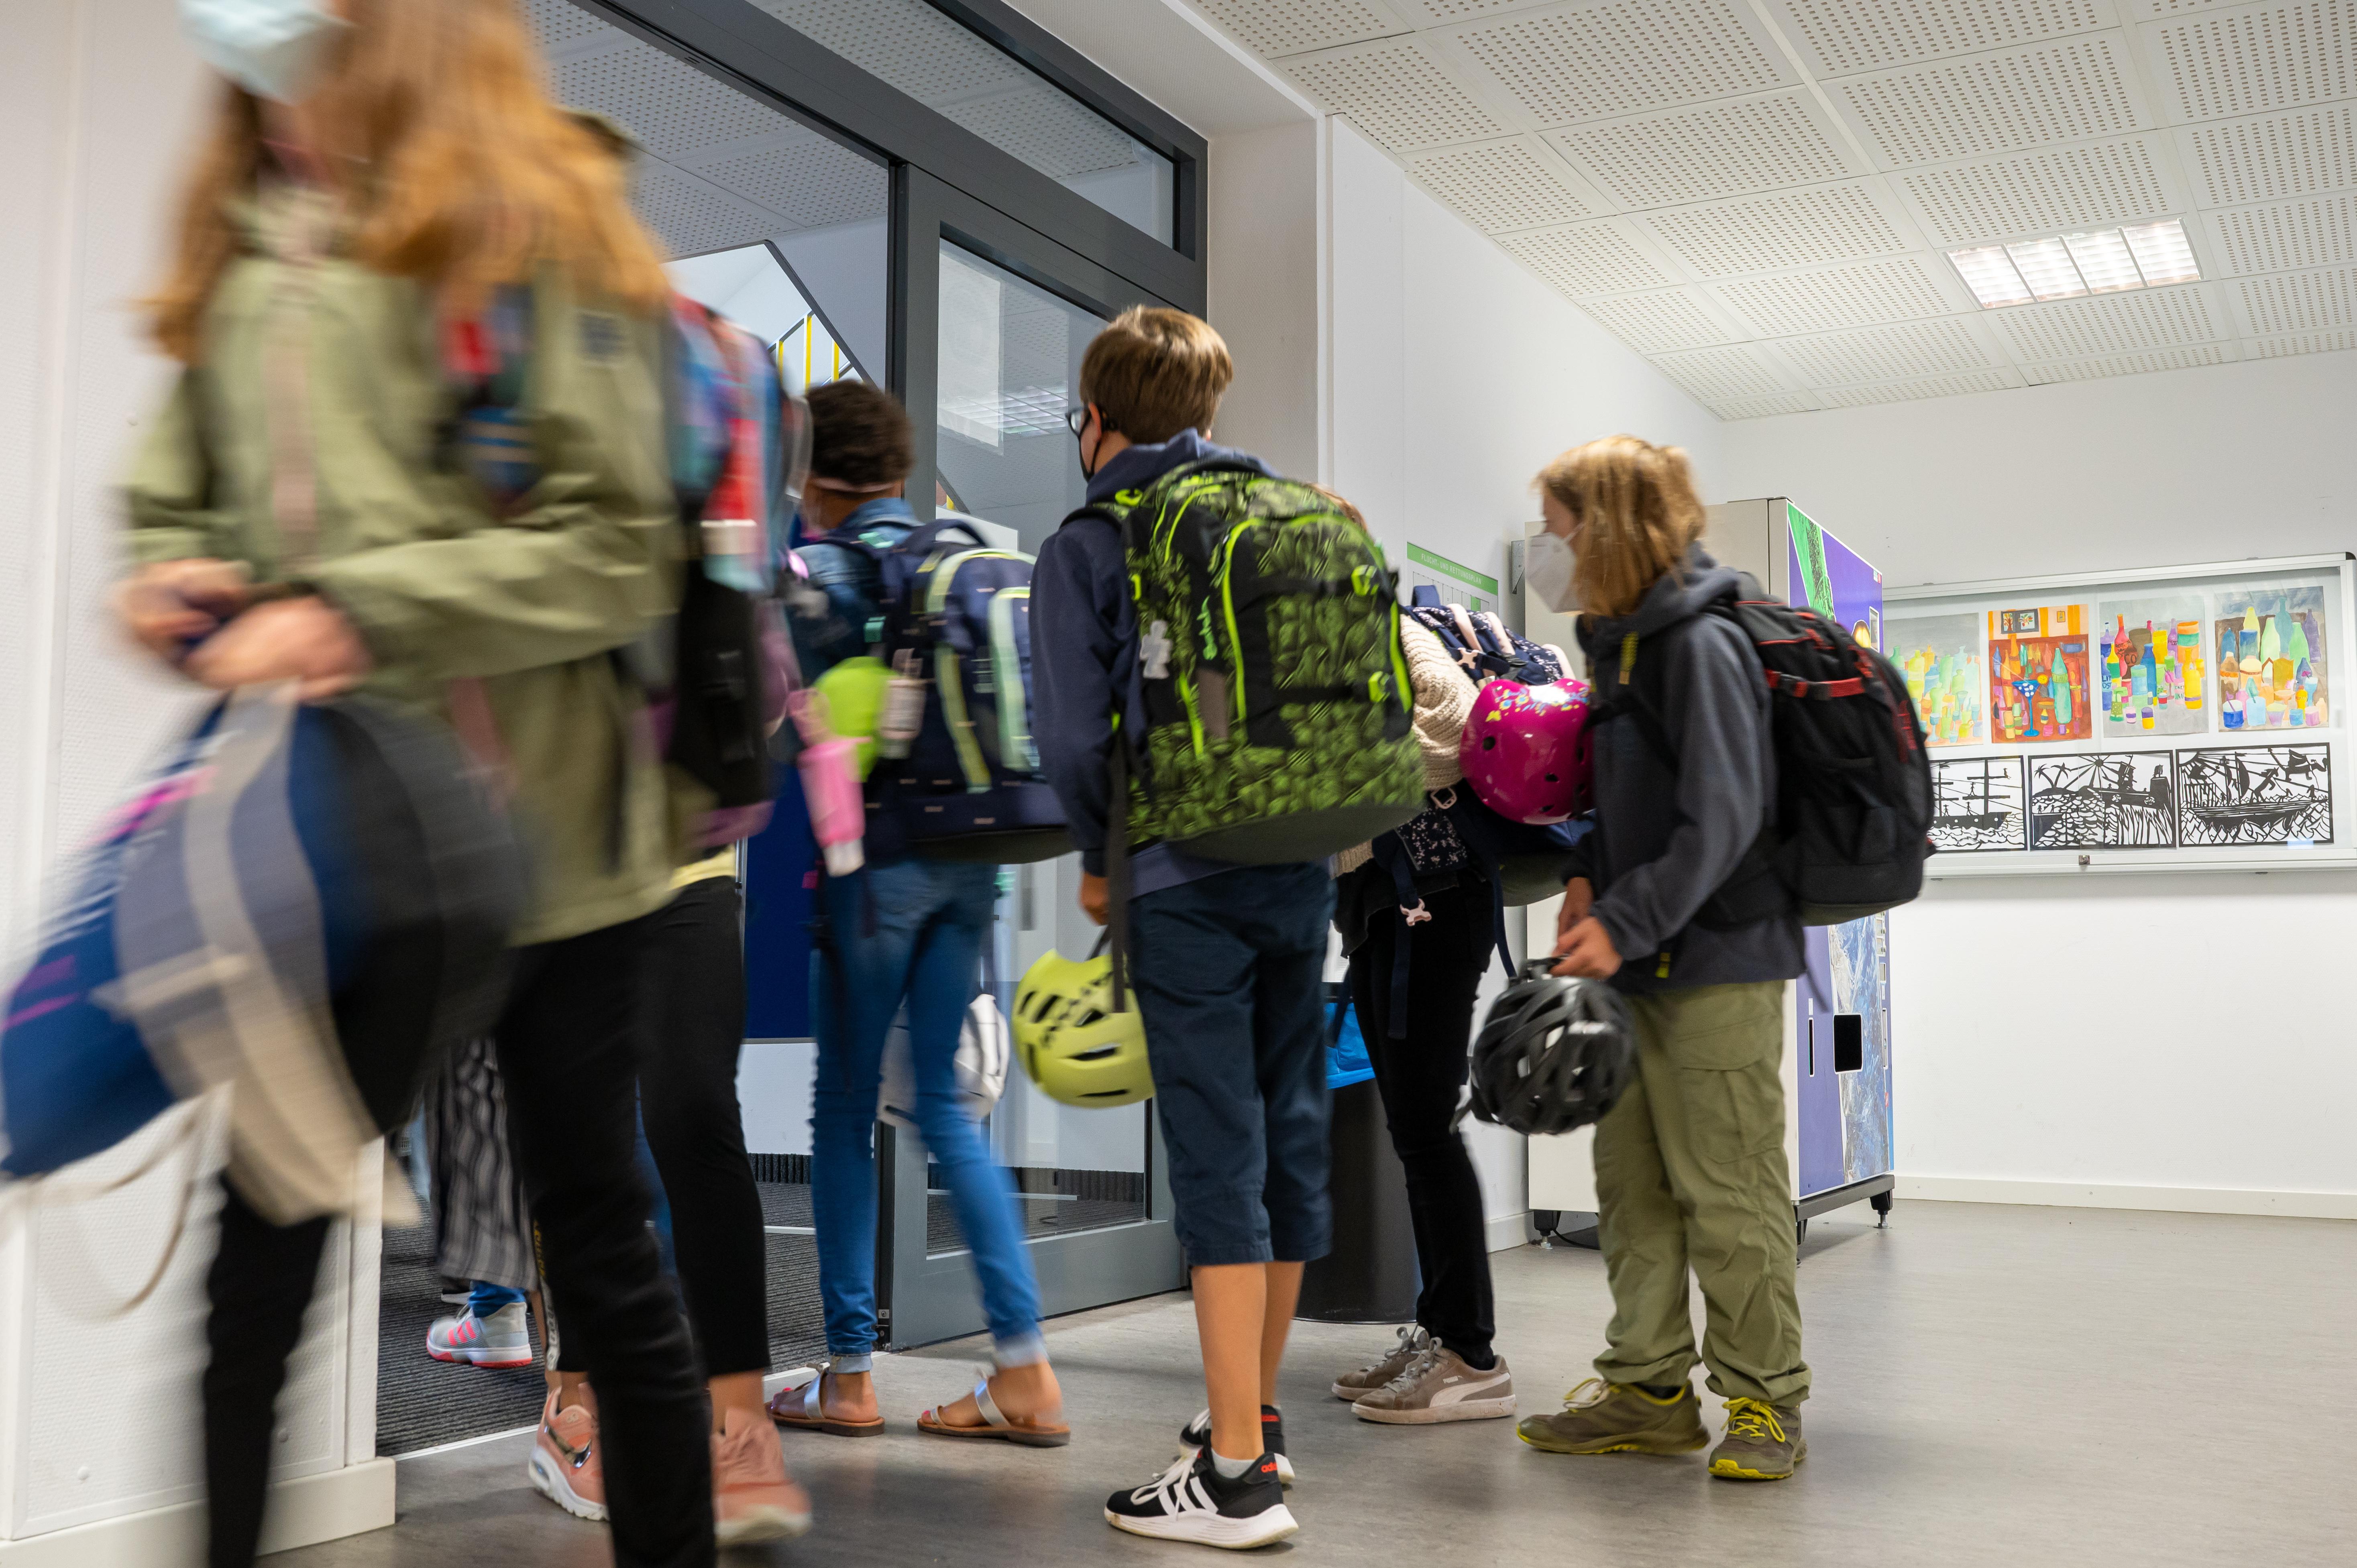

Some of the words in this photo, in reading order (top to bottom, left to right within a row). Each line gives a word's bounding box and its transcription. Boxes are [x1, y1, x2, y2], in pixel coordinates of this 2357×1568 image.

[1421, 553, 1439, 566] FLUCHT-
[1440, 562, 1448, 570] UND
[1450, 565, 1481, 584] RETTUNGSPLAN
